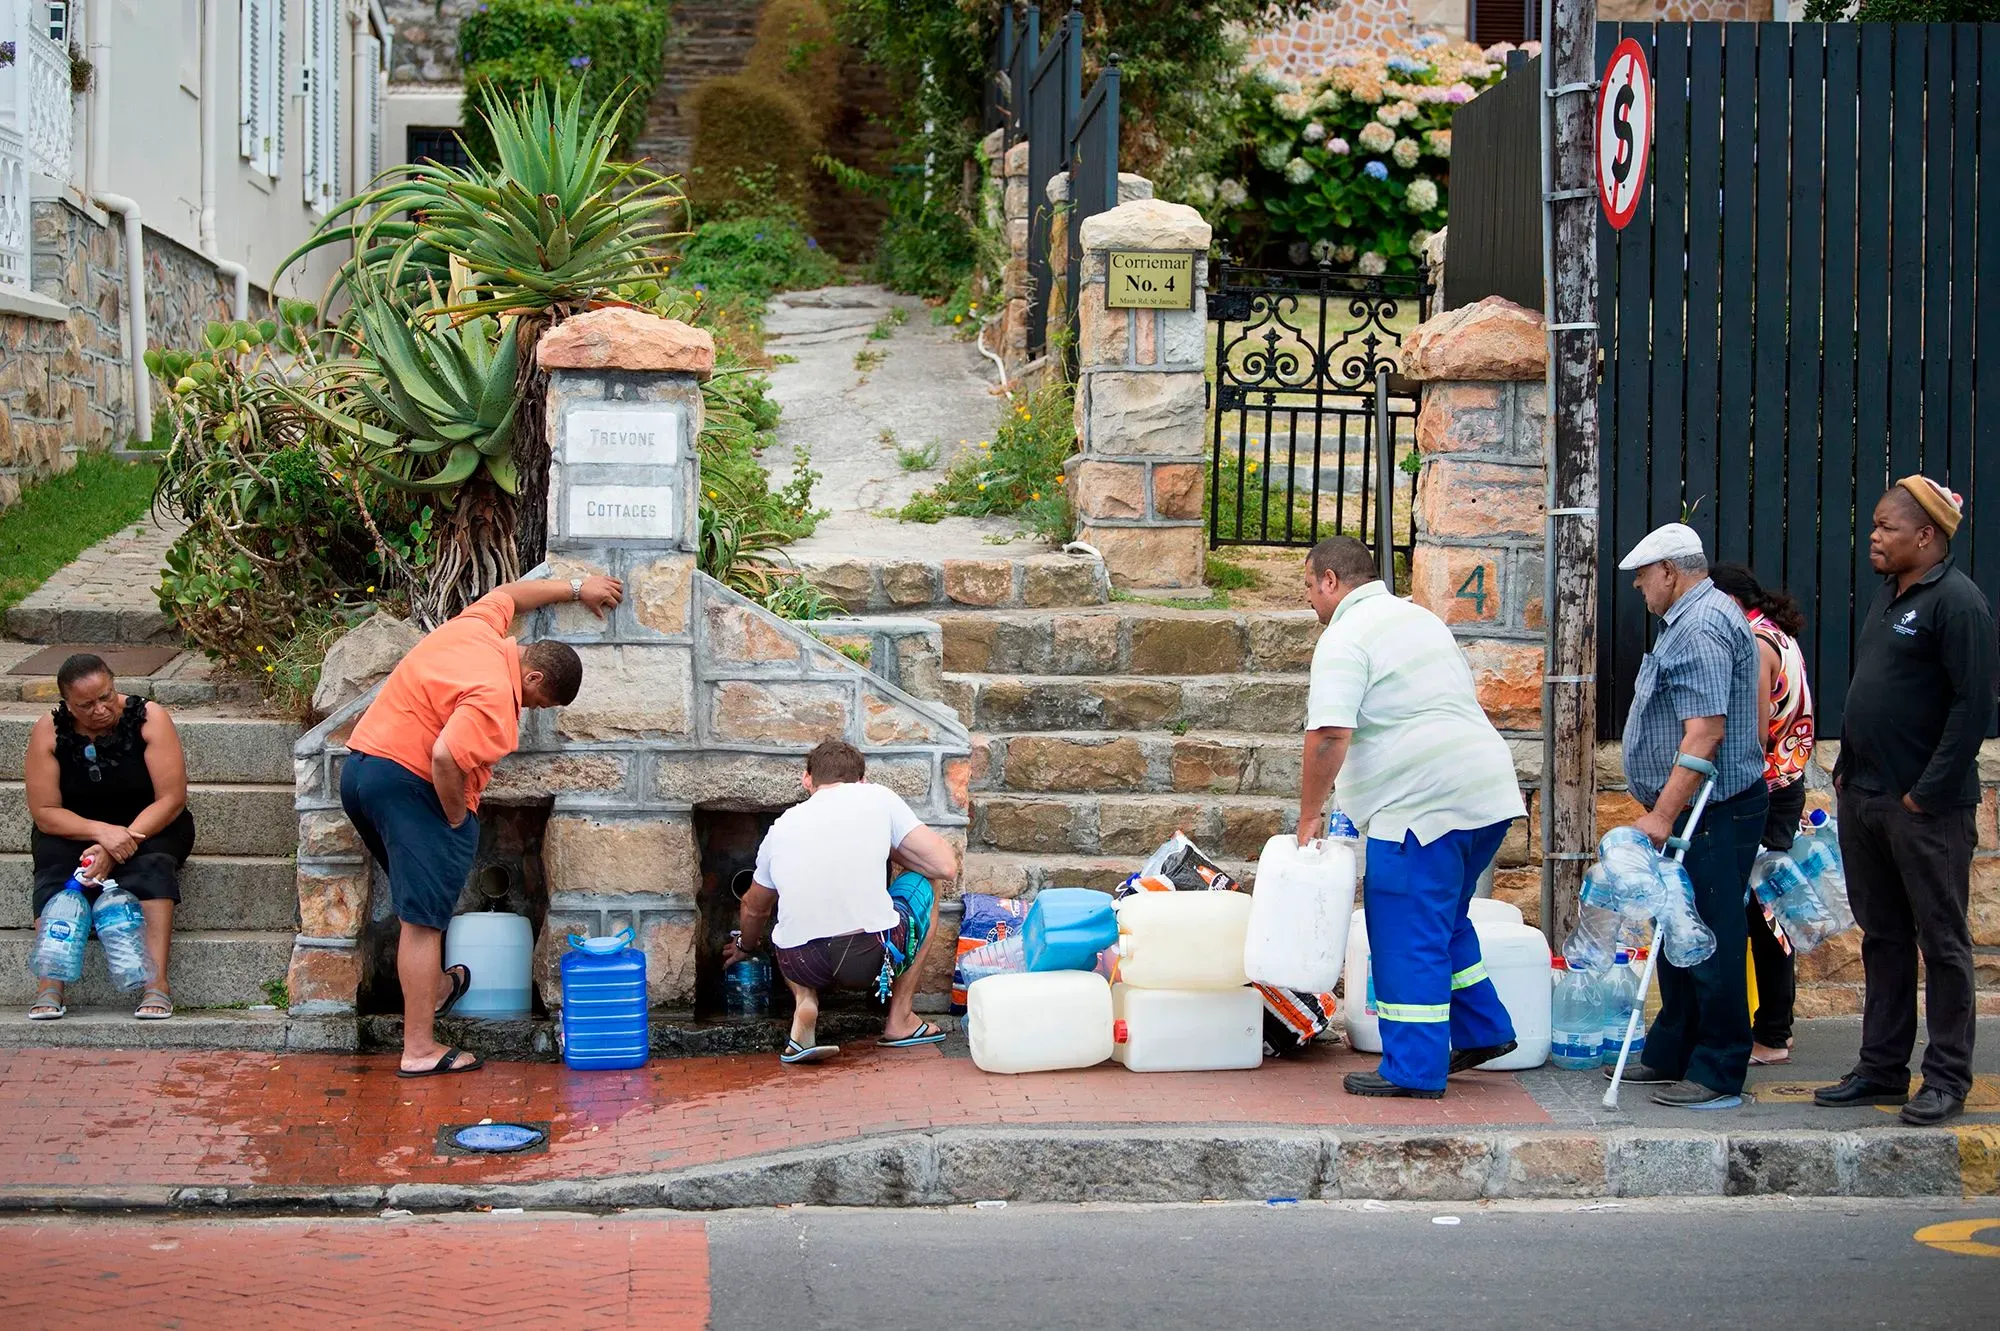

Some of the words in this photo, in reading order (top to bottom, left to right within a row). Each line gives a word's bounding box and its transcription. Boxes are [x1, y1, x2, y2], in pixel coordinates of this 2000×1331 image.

[1112, 254, 1189, 270] Corriemar
[1125, 274, 1158, 292] No.
[1164, 275, 1175, 292] 4
[589, 429, 656, 447] TREVONE
[586, 501, 657, 518] COTTAGES
[1455, 564, 1488, 615] 4
